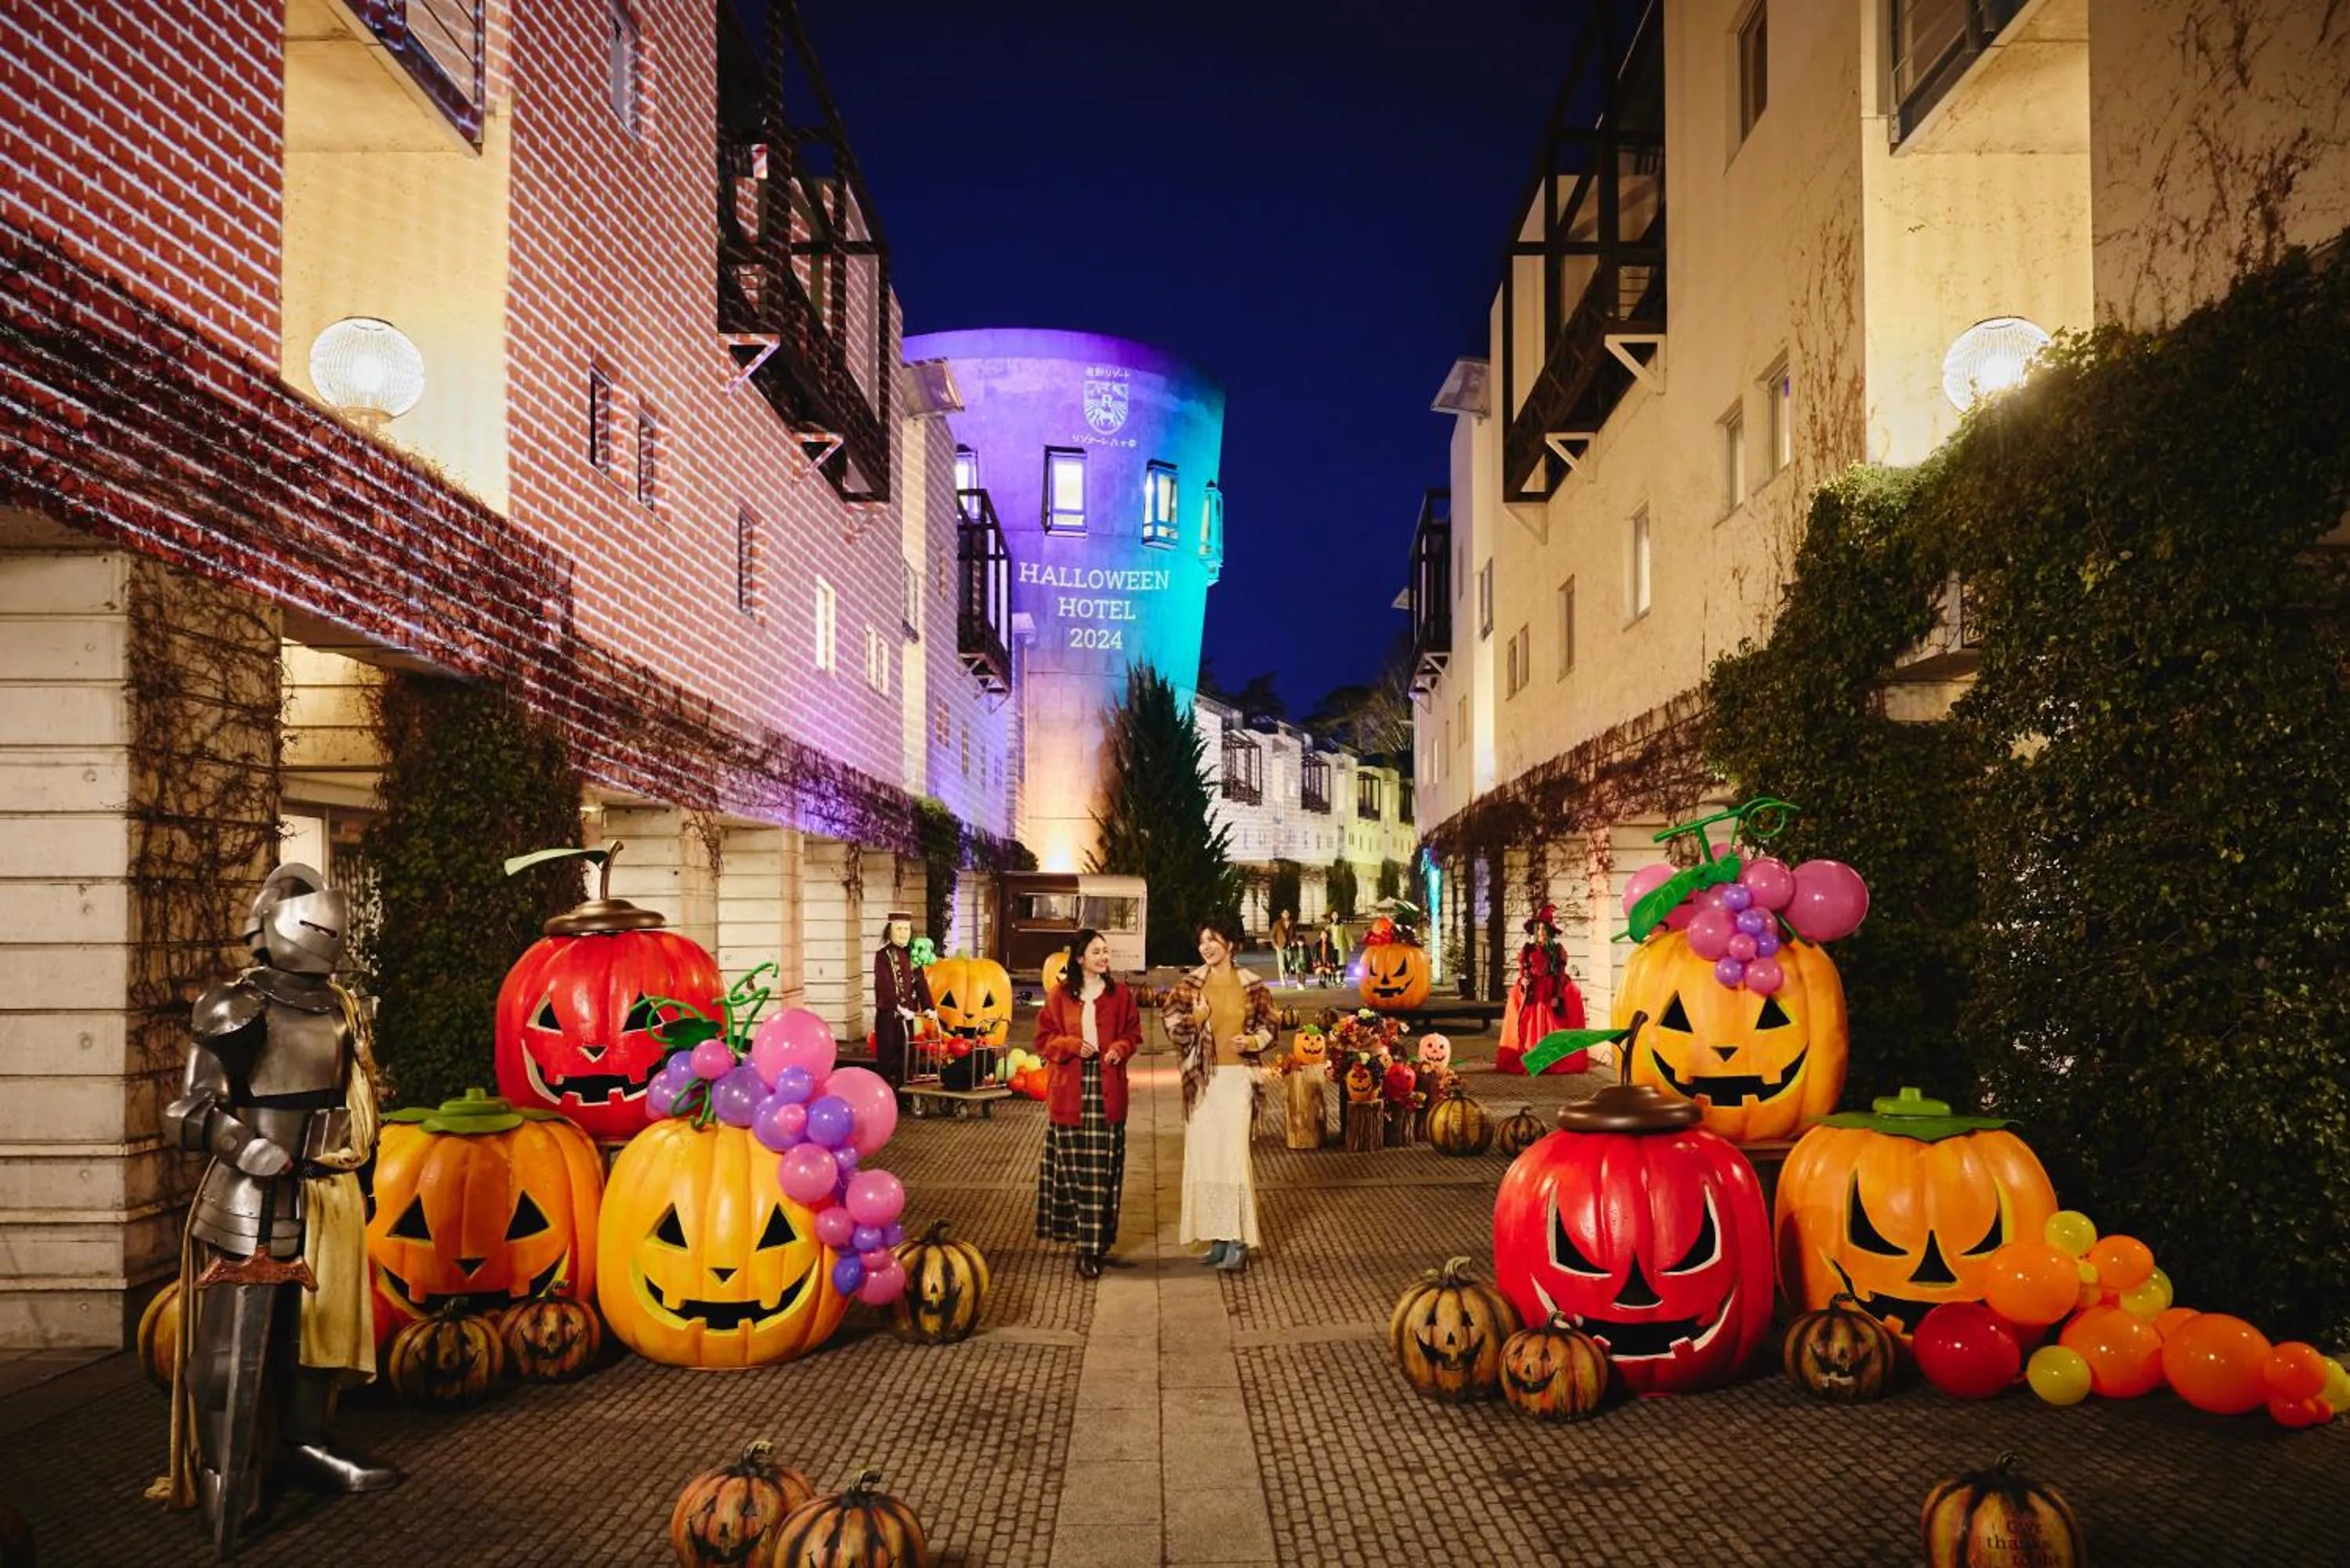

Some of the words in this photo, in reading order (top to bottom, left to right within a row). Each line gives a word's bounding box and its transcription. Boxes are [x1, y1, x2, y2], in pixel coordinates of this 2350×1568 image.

[1018, 562, 1170, 590] HALLOWEEN
[1058, 597, 1137, 620] HOTEL
[1070, 628, 1123, 649] 2024
